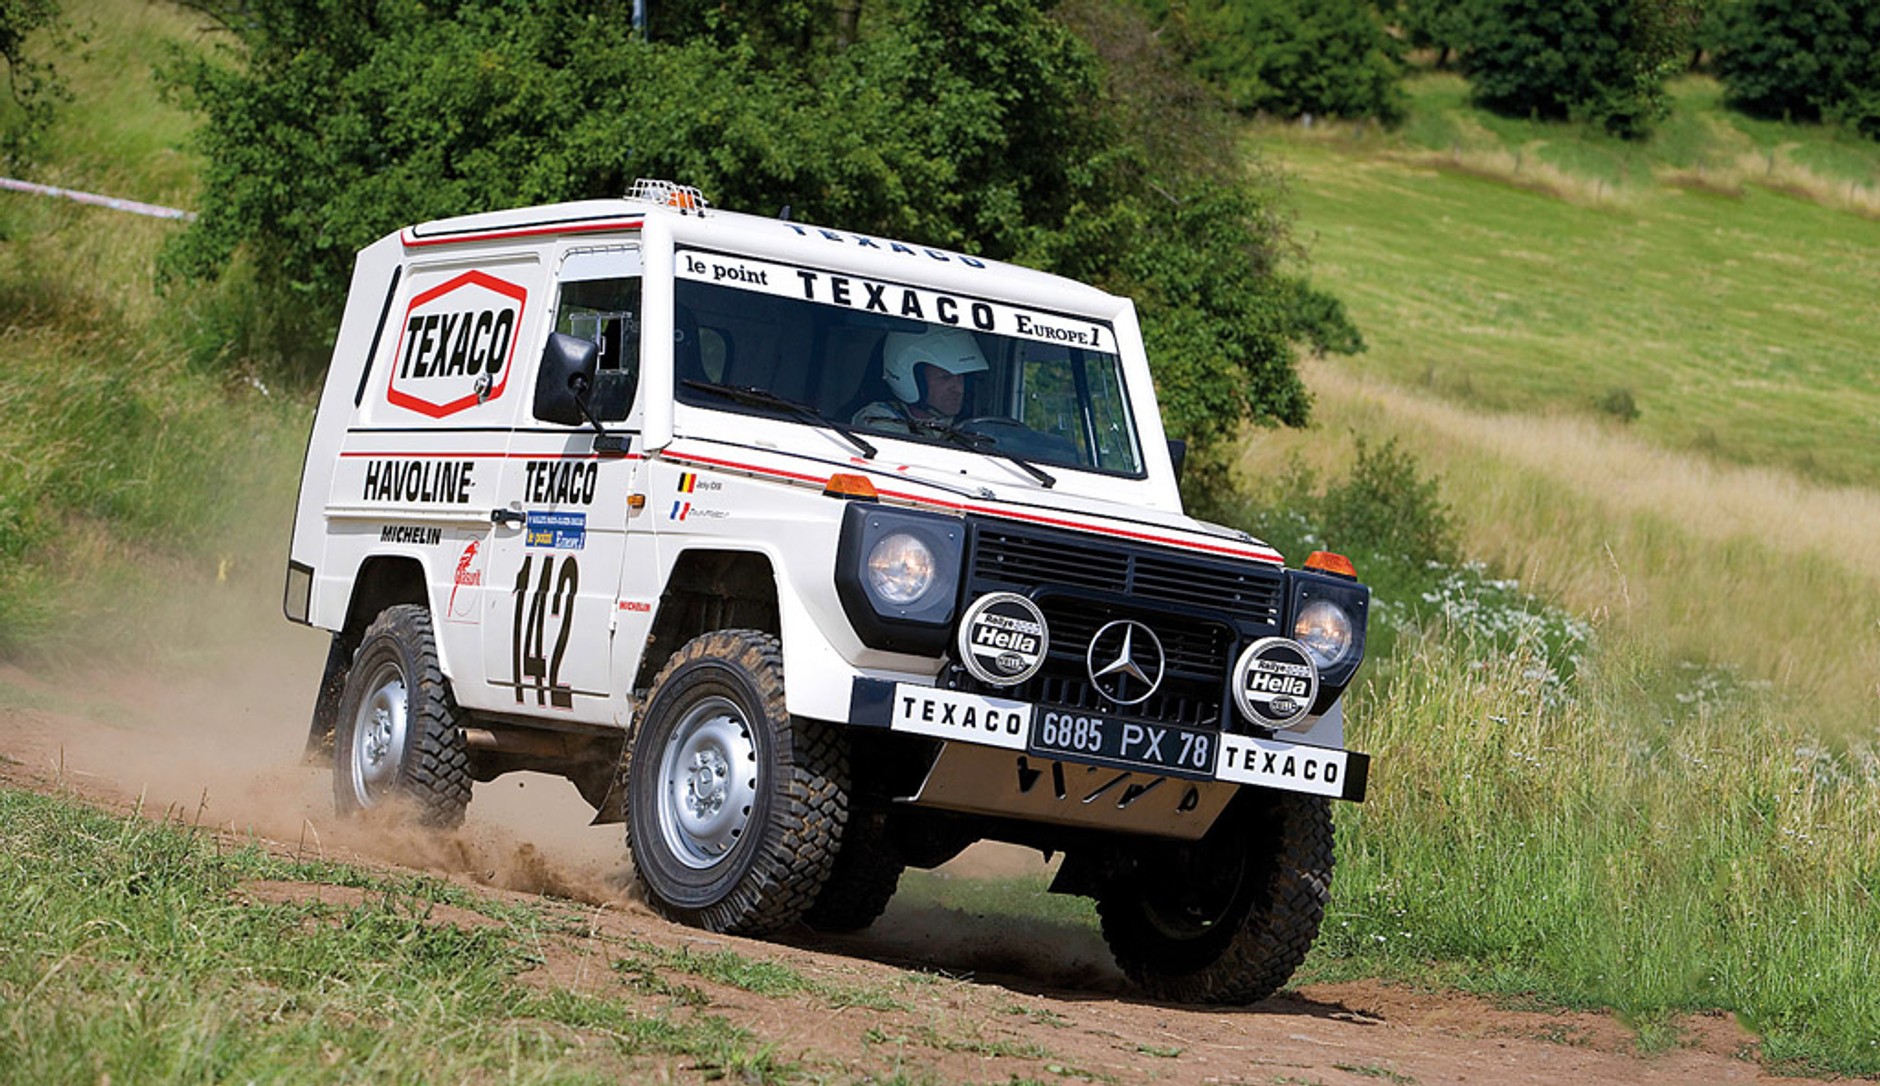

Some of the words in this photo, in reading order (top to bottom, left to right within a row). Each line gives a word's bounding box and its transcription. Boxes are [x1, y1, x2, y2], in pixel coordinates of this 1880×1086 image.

[685, 255, 707, 275] le
[712, 265, 769, 286] point
[797, 270, 996, 332] TEXACO
[400, 309, 515, 379] TEXACO
[524, 461, 598, 505] TEXACO
[380, 525, 442, 546] MICHELIN
[512, 553, 579, 710] 142
[976, 625, 1037, 653] Hella
[1250, 671, 1307, 696] Hella
[903, 697, 1021, 735] TEXACO
[1042, 712, 1103, 752] 6885
[1120, 723, 1167, 762] PX
[1177, 731, 1209, 768] 78
[1226, 746, 1338, 785] TEXACO
